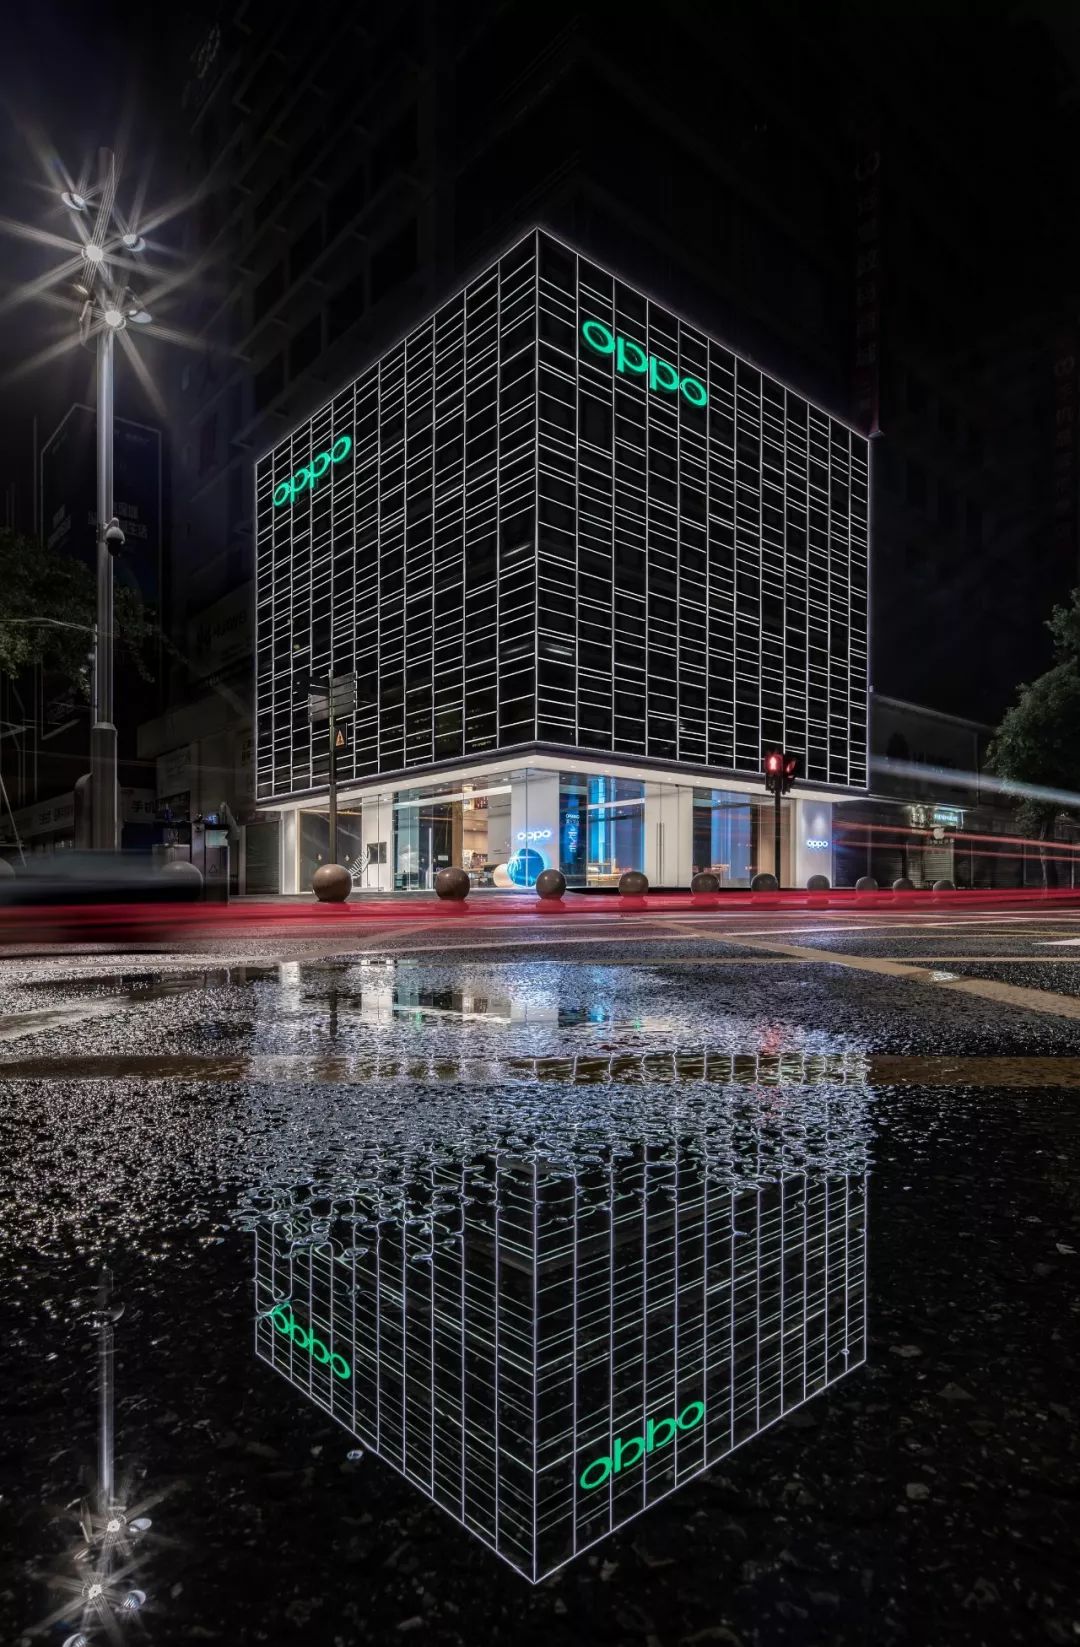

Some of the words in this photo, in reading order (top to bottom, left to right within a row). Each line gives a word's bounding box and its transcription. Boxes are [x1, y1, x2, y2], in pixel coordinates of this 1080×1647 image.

[581, 320, 709, 407] oppo
[272, 436, 352, 507] oppo
[516, 829, 551, 841] oppo
[806, 839, 829, 849] oppo
